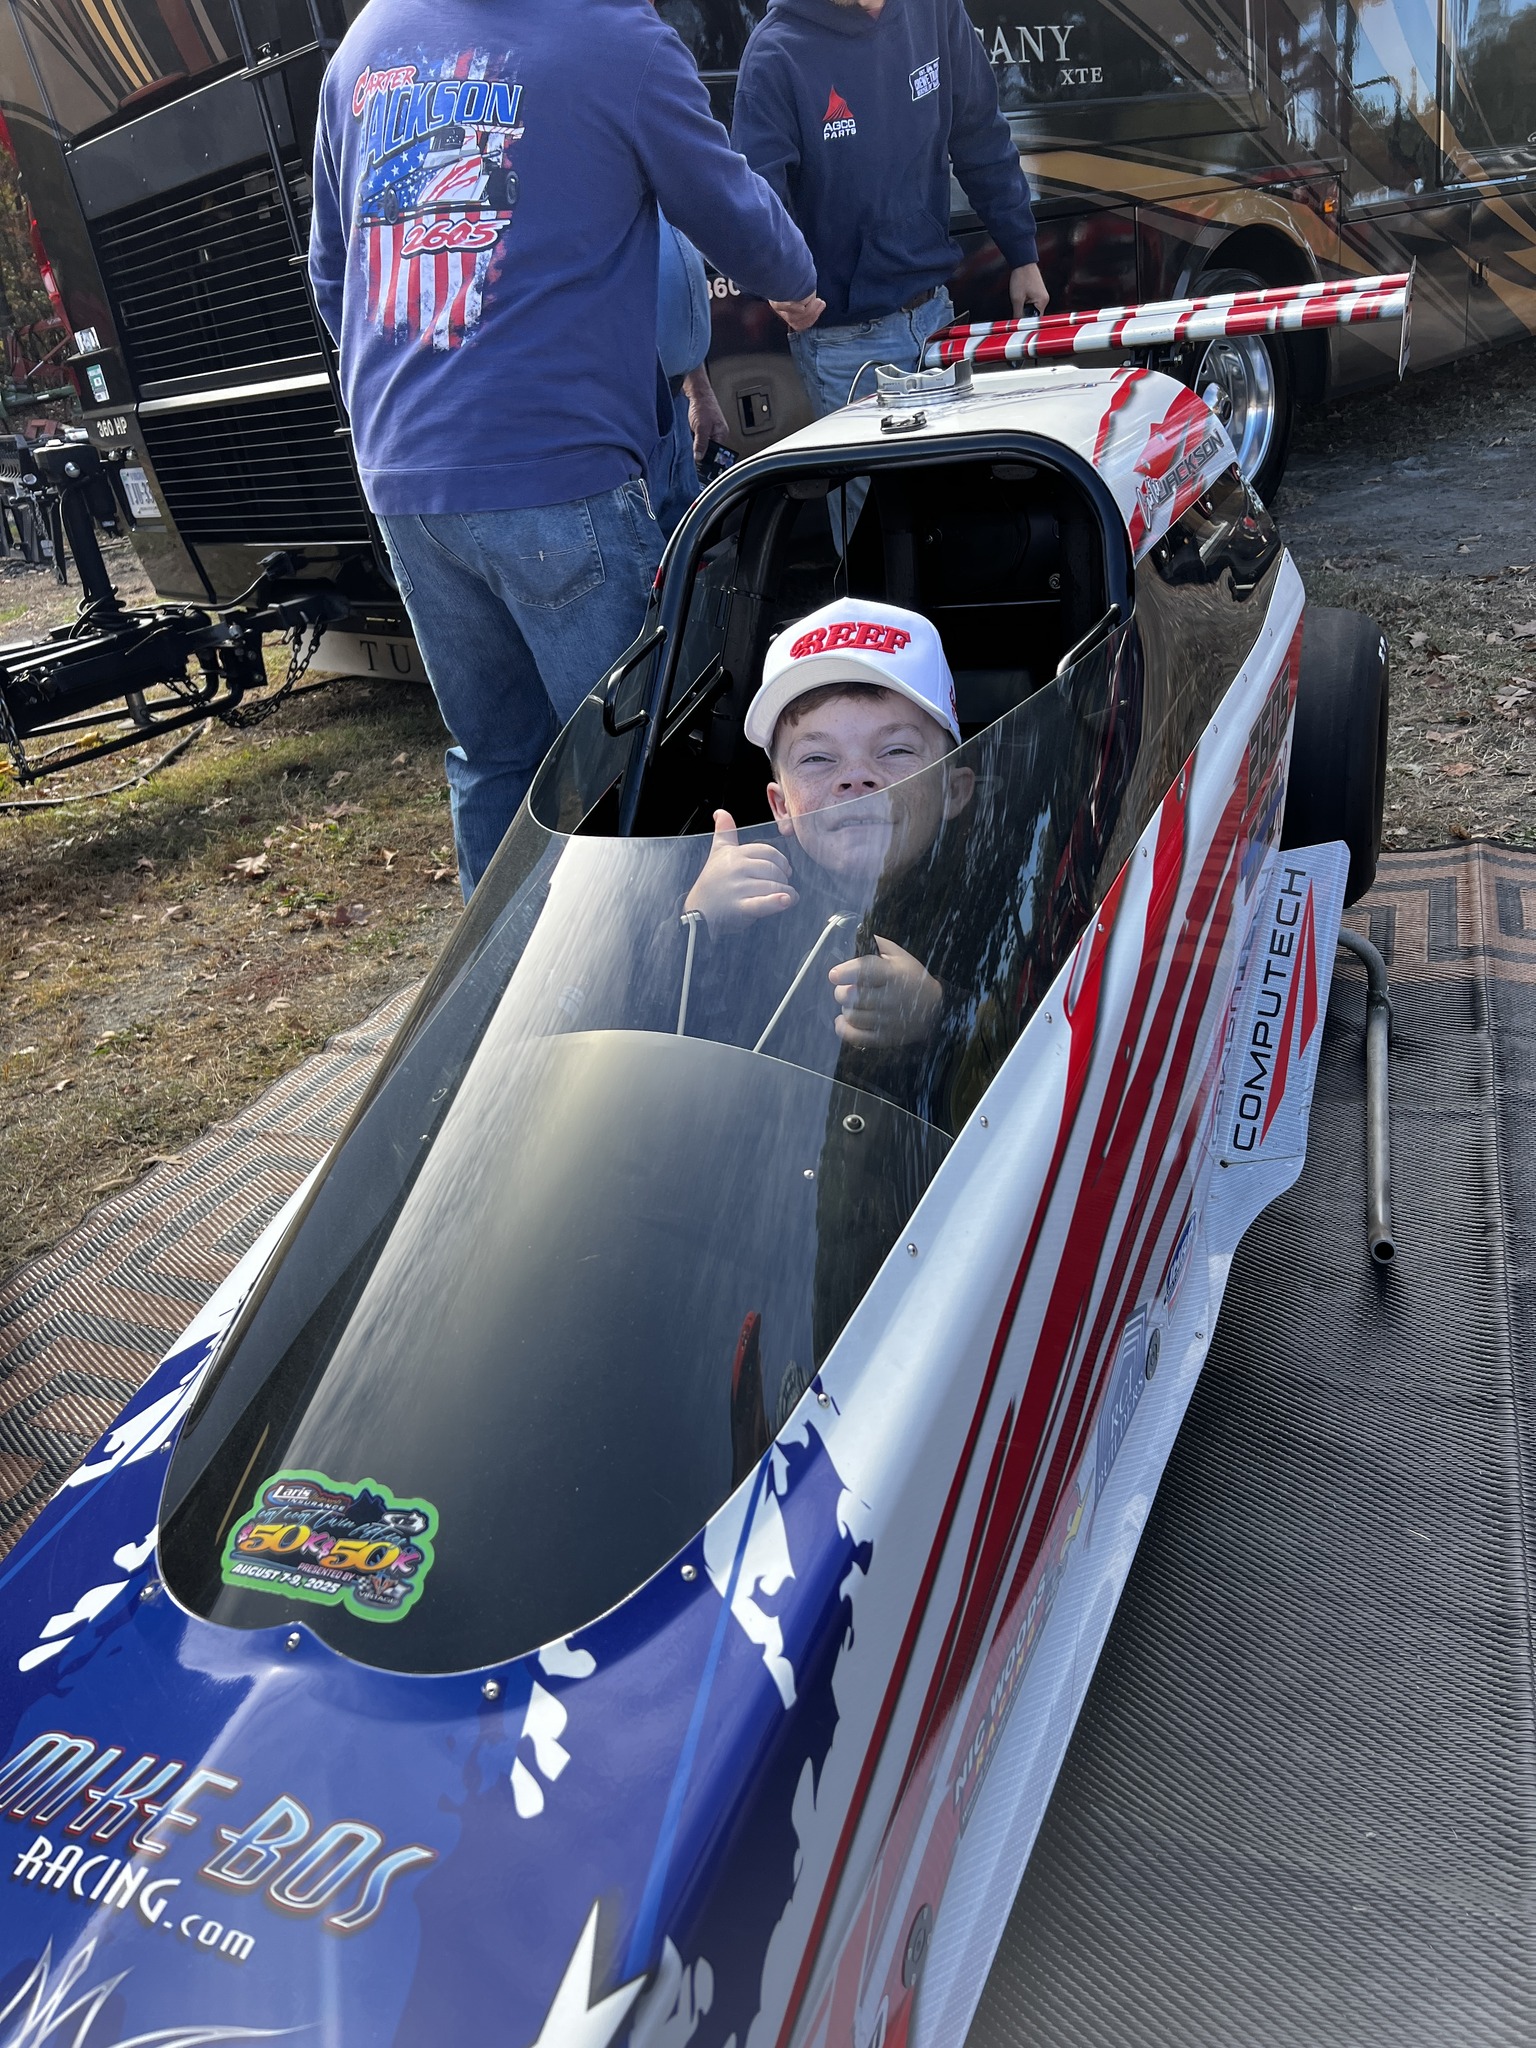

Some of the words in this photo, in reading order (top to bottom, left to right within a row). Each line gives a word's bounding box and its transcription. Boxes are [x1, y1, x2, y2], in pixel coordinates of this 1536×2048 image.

[353, 65, 417, 117] CARTER
[1060, 67, 1103, 86] XTE
[823, 118, 856, 132] AGCO
[823, 127, 857, 140] PARTS
[401, 218, 511, 256] 2605
[97, 420, 115, 437] 360
[114, 416, 128, 436] HP
[1157, 428, 1225, 504] JACKSON
[790, 621, 911, 660] BEEF
[1233, 867, 1306, 1151] COMPUTECH
[272, 1485, 312, 1499] Laris
[288, 1498, 346, 1511] INSURANCE
[231, 1563, 282, 1581] AUGUST
[303, 1576, 341, 1594] 2025
[297, 1562, 342, 1580] PRESENTED
[341, 1572, 356, 1582] BY
[955, 1719, 985, 1806] NIC
[990, 1572, 1047, 1716] WOODS
[975, 1624, 1036, 1777] RACING
[0, 1731, 240, 1854] MIKE
[201, 1794, 437, 1930] BOS
